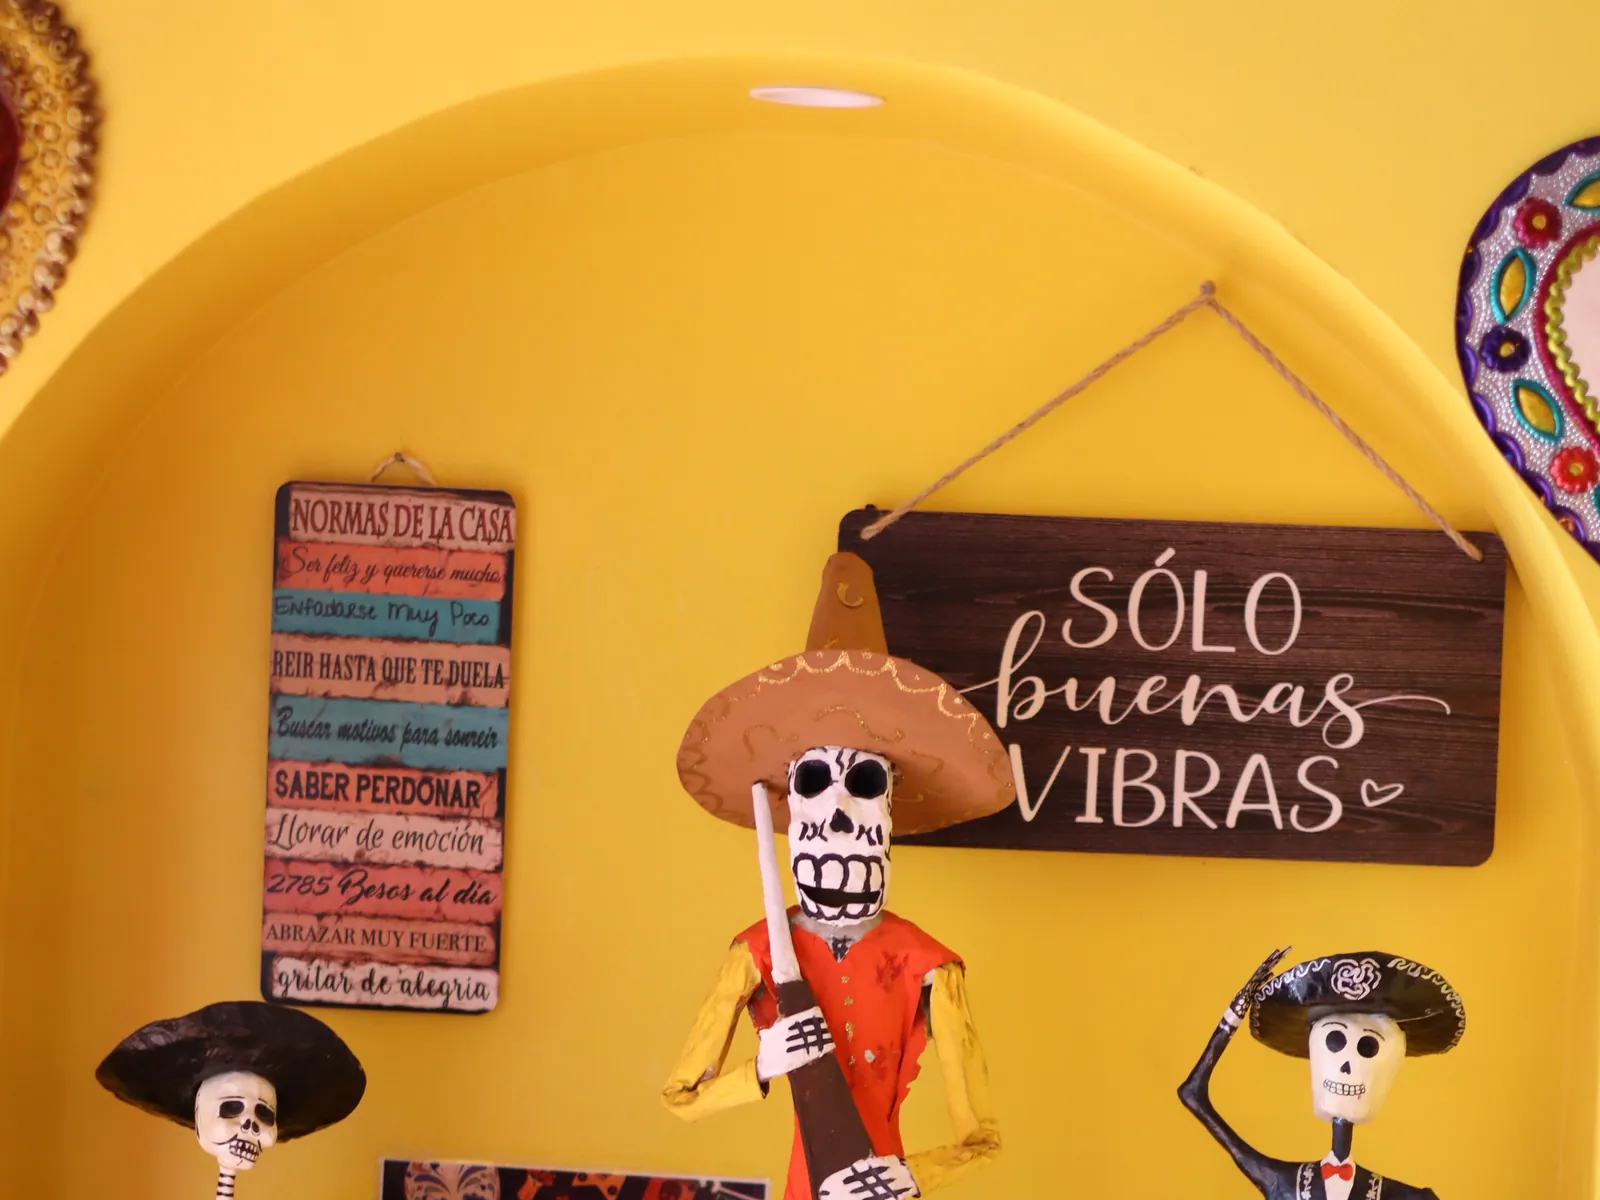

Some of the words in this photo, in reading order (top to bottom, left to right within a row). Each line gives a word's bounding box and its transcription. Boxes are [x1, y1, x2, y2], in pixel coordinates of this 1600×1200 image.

[291, 498, 389, 538] NORMAS
[393, 504, 424, 538] DE
[427, 506, 455, 543] LA
[459, 506, 514, 545] CASA
[282, 546, 321, 575] Ser
[323, 554, 359, 583] feliz
[360, 564, 378, 584] y
[384, 563, 445, 584] quererse
[450, 563, 500, 584] mucho
[451, 600, 490, 626] Poco
[1061, 547, 1302, 655] SÓLO
[272, 648, 314, 678] REIR
[319, 652, 376, 682] HASTA
[382, 656, 417, 685] QUE
[421, 659, 444, 686] TE
[448, 660, 504, 689] DUELA
[957, 610, 1450, 749] buenas
[276, 706, 332, 739] Buscar
[337, 718, 397, 744] motivos
[400, 721, 440, 752] para
[275, 769, 350, 802] SABER
[1008, 743, 1344, 833] VIBRAS
[268, 813, 350, 850] Llorar
[356, 818, 384, 850] de
[392, 821, 484, 855] emoción
[266, 873, 332, 895] 2785
[337, 868, 414, 908] Besos
[420, 877, 449, 904] al
[266, 923, 355, 945] ABRAZAR
[360, 929, 403, 949] MUY
[409, 931, 488, 953] FUERTE
[278, 962, 352, 999] gritar
[361, 967, 392, 995] de
